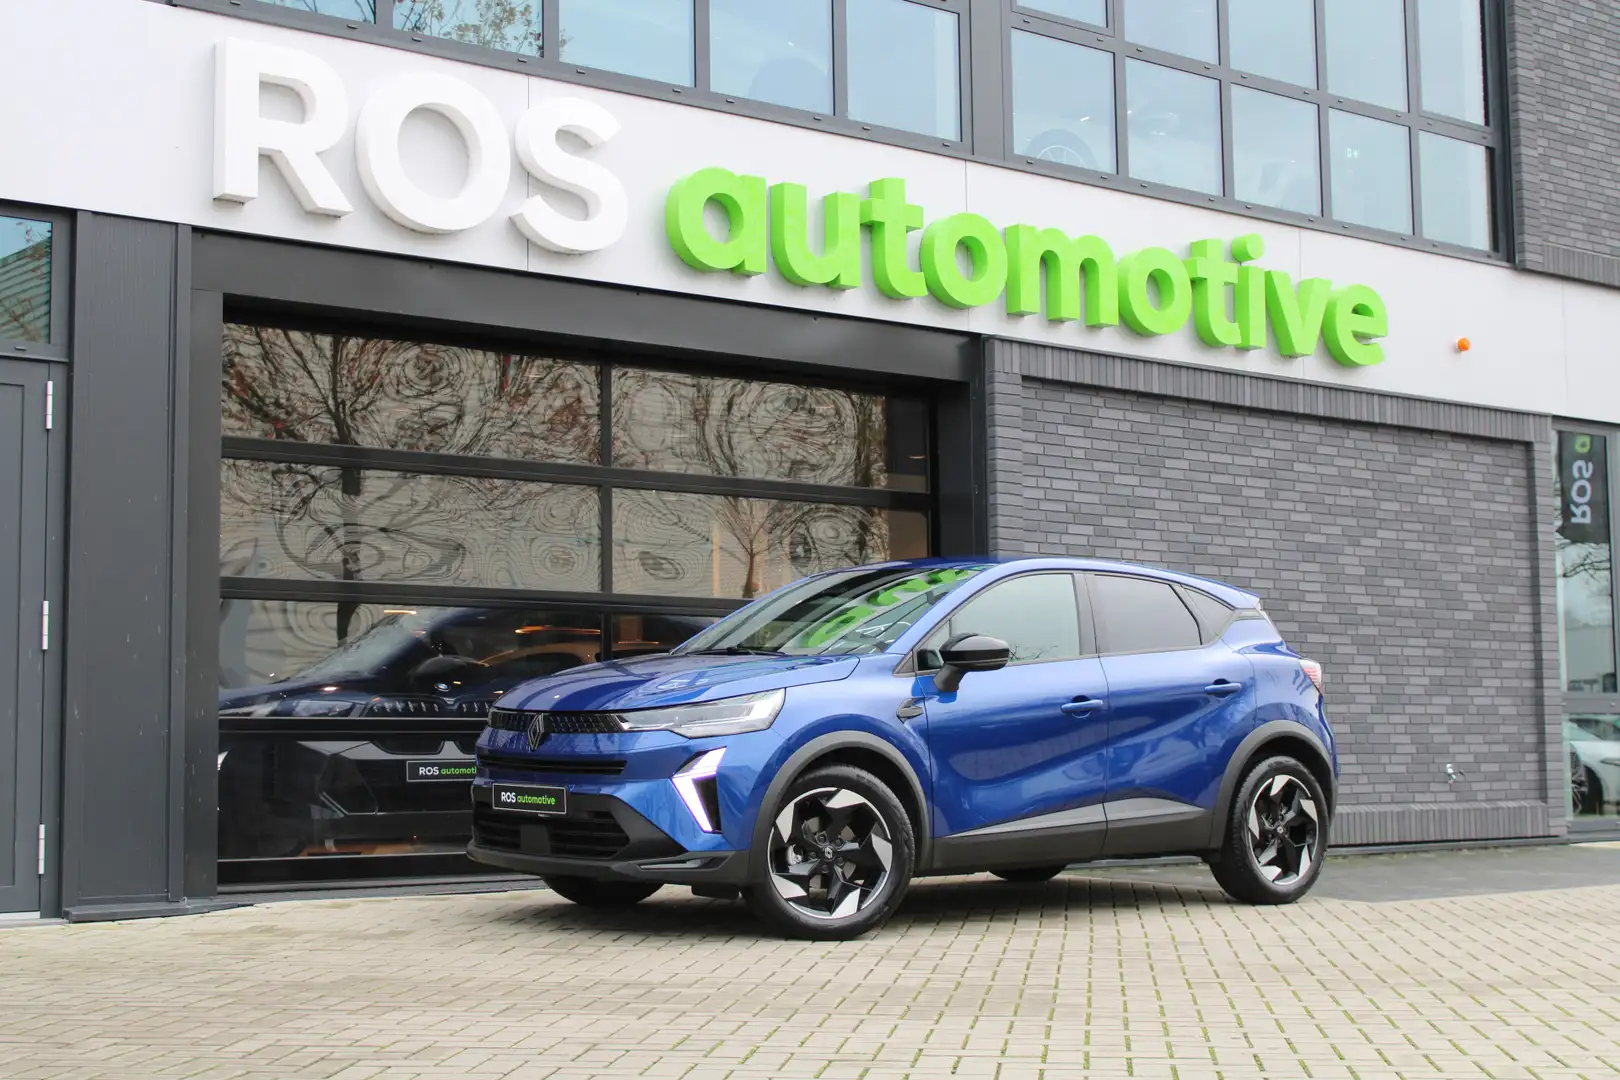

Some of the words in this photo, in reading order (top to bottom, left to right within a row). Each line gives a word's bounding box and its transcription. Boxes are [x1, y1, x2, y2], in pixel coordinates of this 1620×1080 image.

[213, 37, 629, 255] ROS
[665, 167, 1389, 367] automotive
[418, 766, 440, 776] ROS
[441, 766, 477, 775] automoti
[500, 791, 516, 803] ROS
[517, 794, 556, 805] automotive
